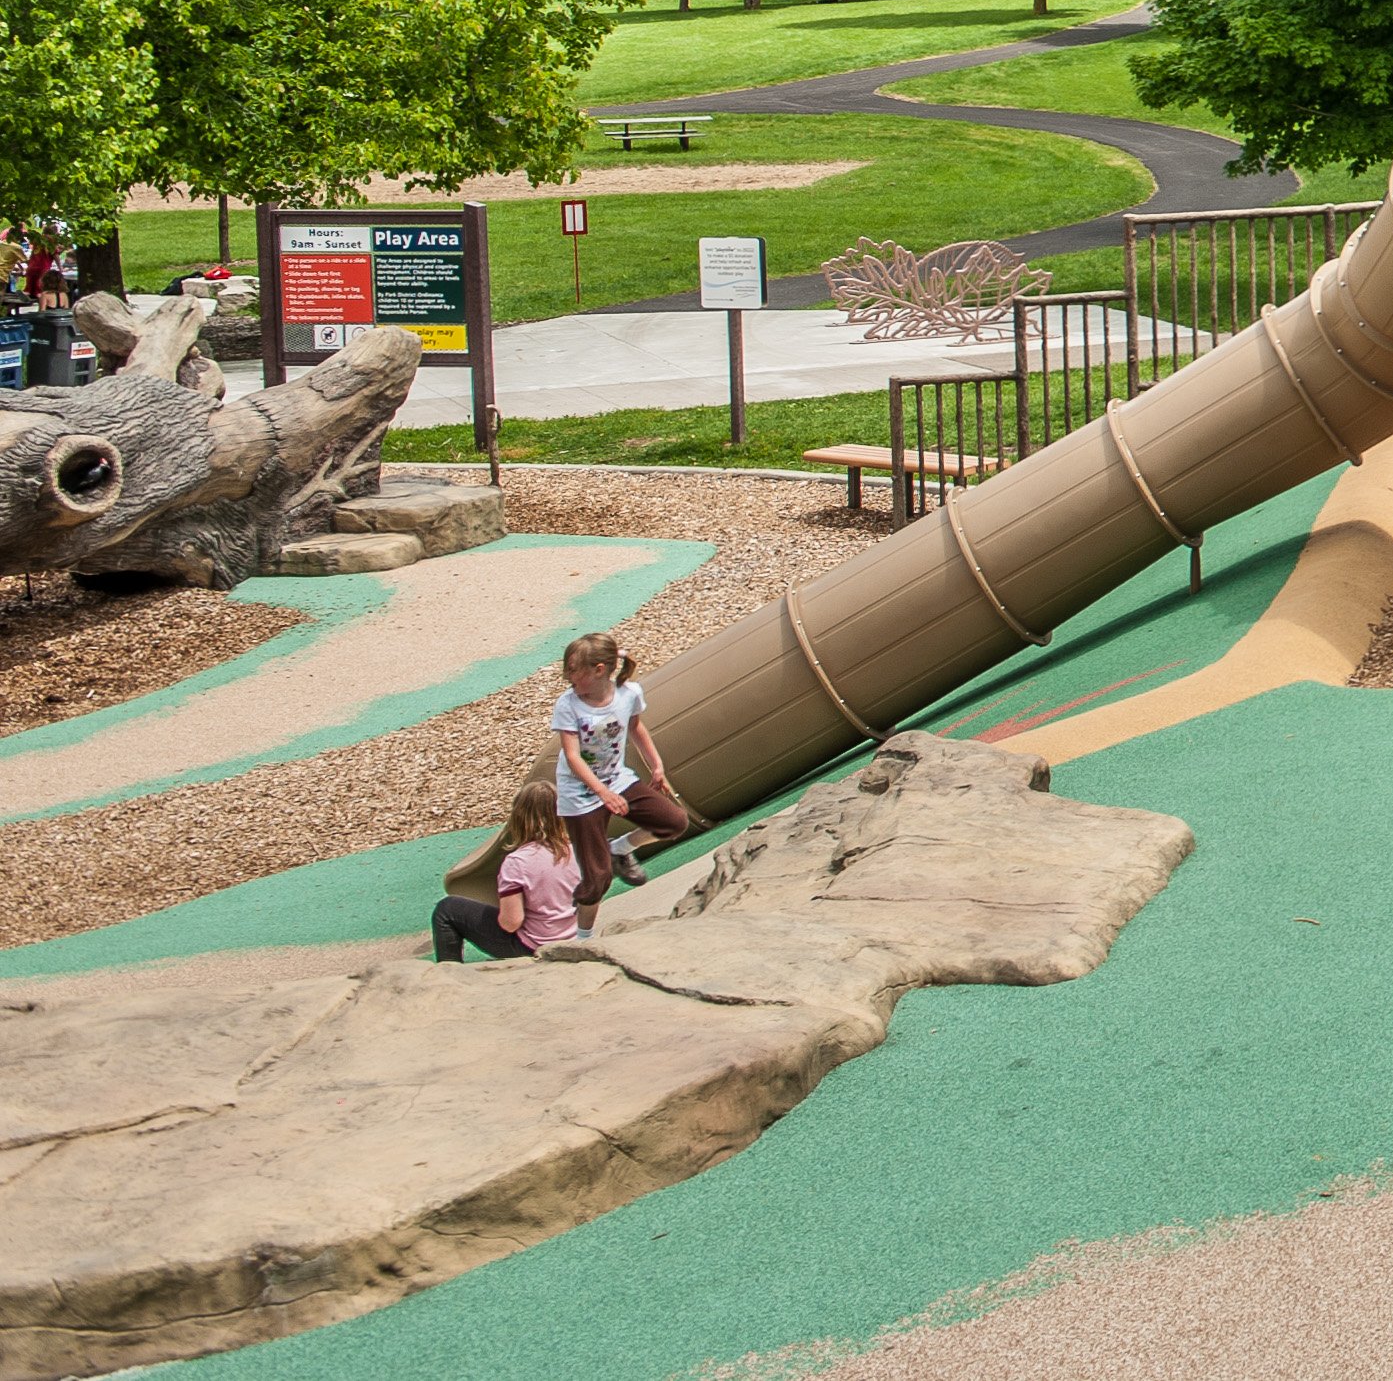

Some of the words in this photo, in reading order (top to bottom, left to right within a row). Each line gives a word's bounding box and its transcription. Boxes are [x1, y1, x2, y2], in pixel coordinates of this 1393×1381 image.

[291, 240, 313, 248] 9am
[325, 240, 362, 248] Sunset
[375, 231, 412, 249] Play
[418, 231, 459, 246] Area
